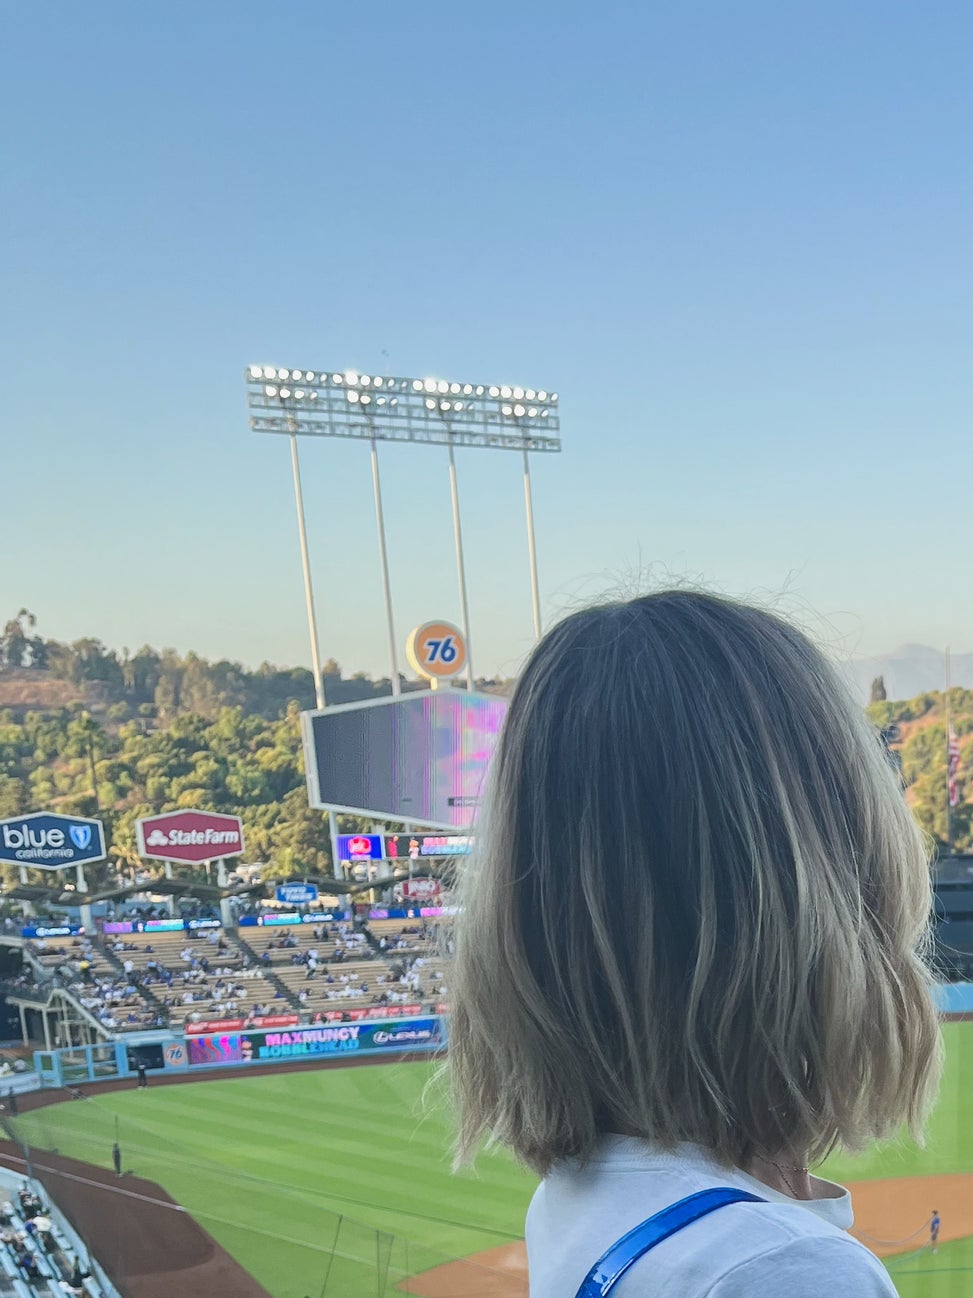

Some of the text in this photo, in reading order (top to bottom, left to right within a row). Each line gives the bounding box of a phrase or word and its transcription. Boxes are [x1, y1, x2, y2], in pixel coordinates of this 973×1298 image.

[426, 636, 457, 663] 76
[2, 824, 65, 848] blue
[388, 1030, 431, 1042] LEXUS
